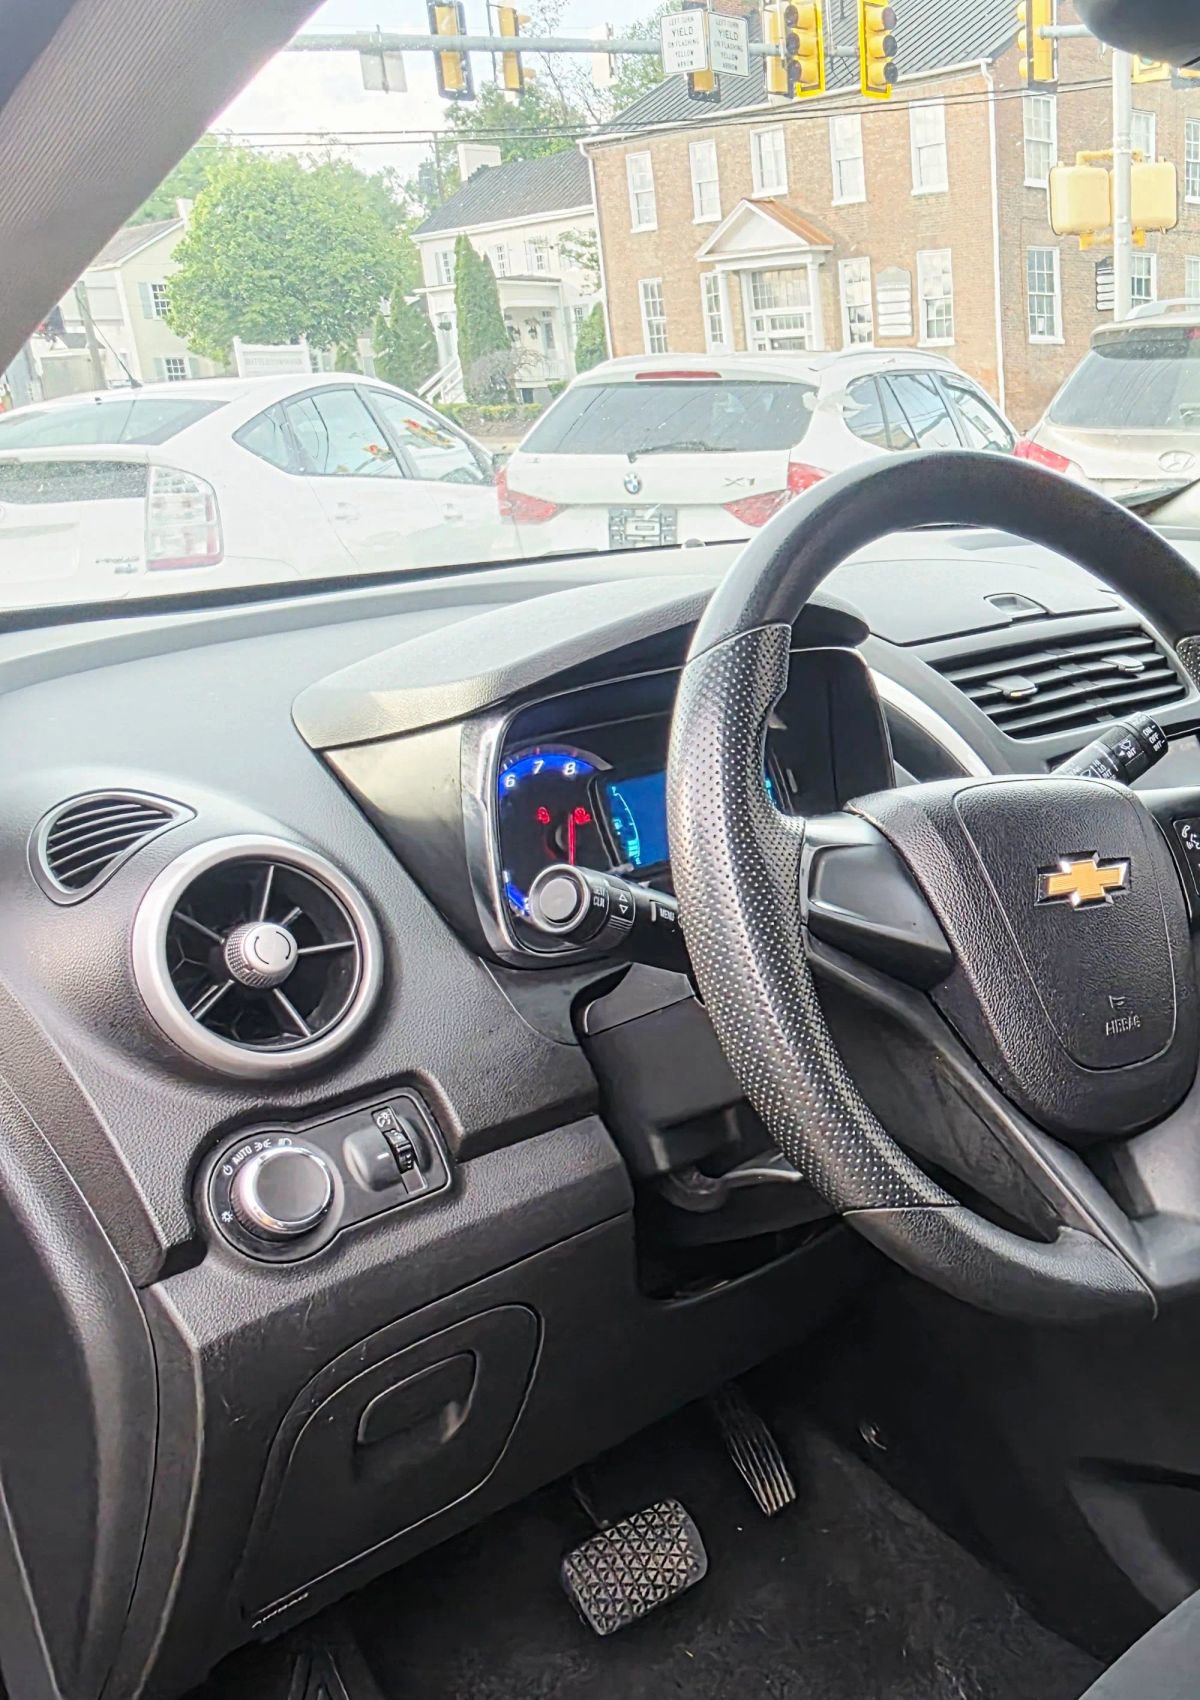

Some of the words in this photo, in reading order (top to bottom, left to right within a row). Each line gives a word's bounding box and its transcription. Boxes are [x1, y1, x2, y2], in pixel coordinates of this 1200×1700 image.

[672, 26, 694, 37] YIELD
[718, 29, 739, 41] YIELD
[722, 477, 755, 487] X1
[1148, 732, 1159, 744] OFF
[1126, 747, 1137, 759] INT
[533, 760, 545, 775] 7
[563, 761, 577, 776] 8
[505, 774, 516, 788] 6
[660, 907, 675, 922] MENU
[231, 1145, 253, 1165] AUTO
